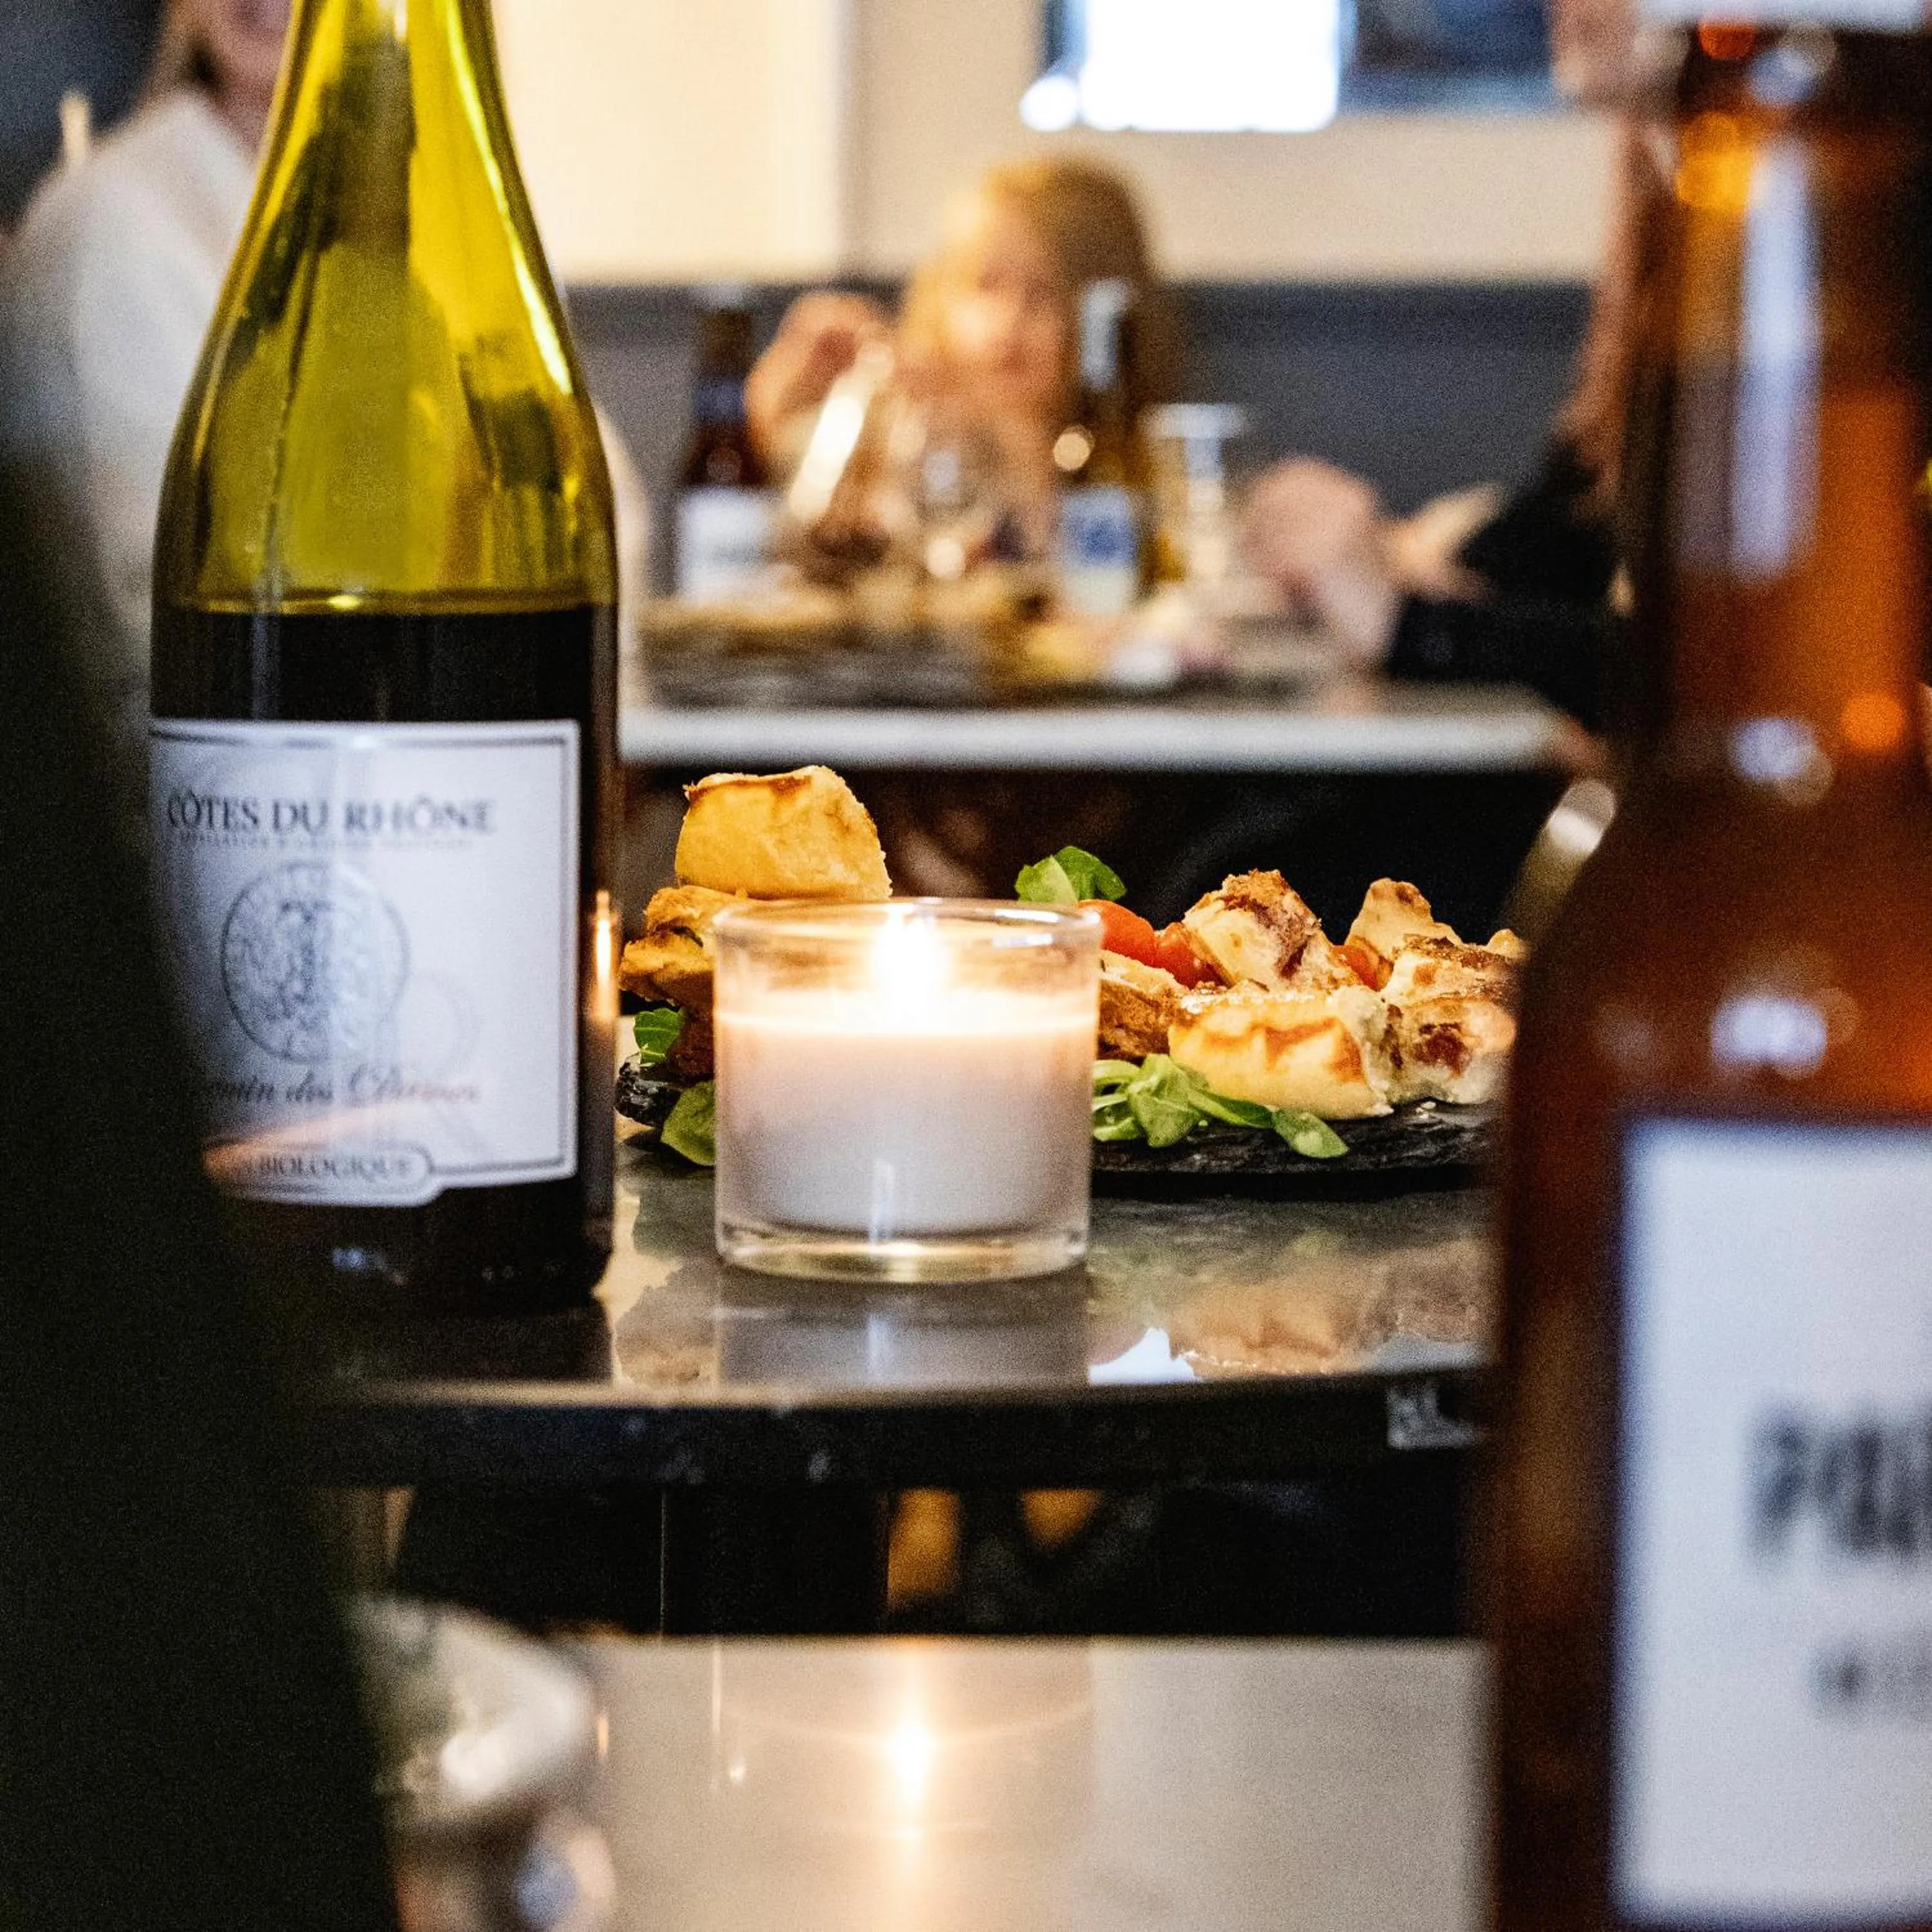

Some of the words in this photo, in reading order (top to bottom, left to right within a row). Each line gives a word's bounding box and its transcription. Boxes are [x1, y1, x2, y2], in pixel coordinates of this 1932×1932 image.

[271, 798, 328, 835] DU
[345, 794, 497, 836] RHÔNE
[258, 1153, 412, 1180] BIOLOGIQUE
